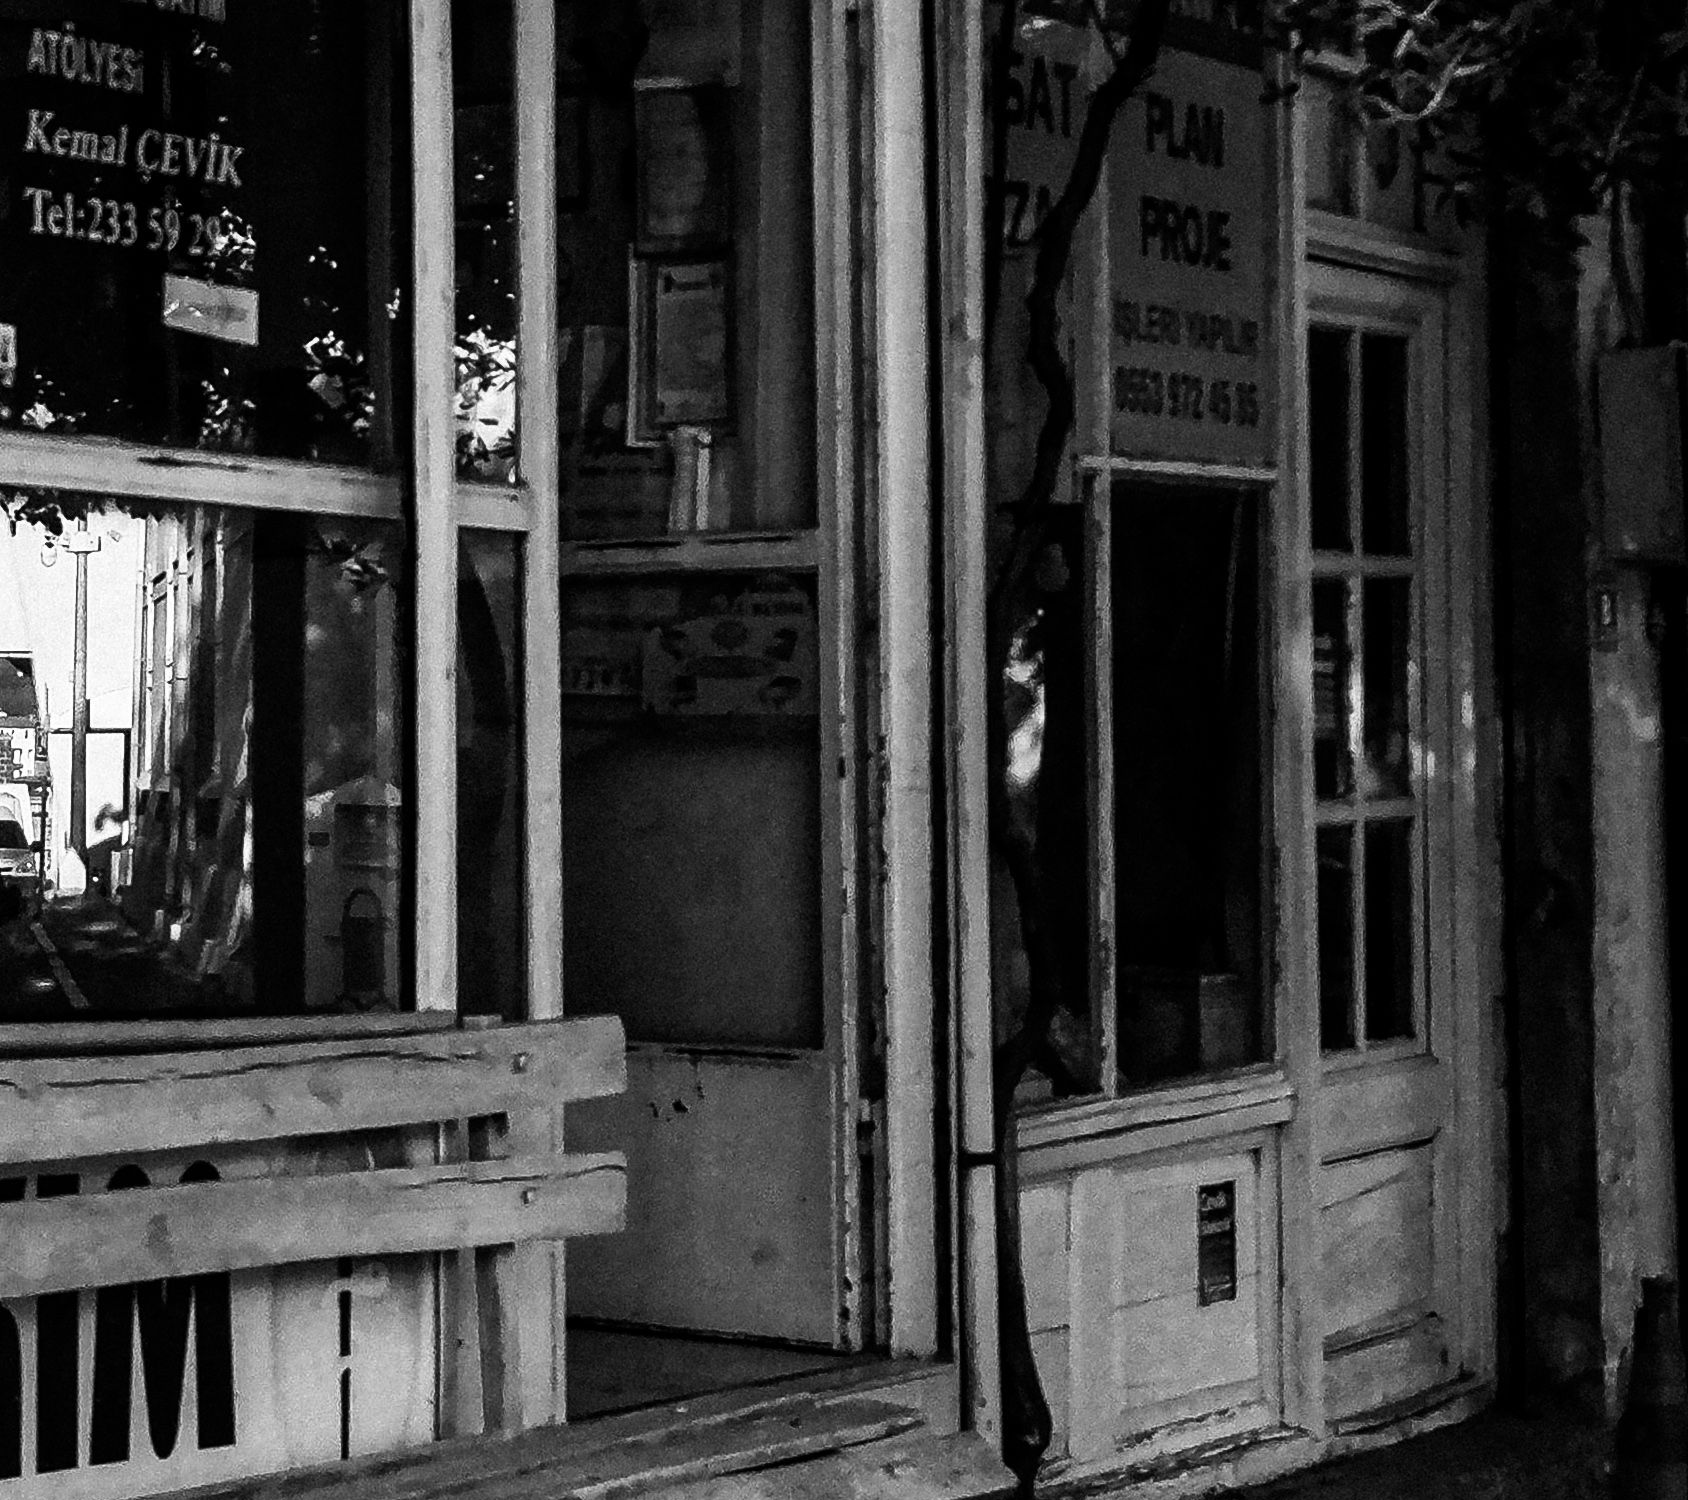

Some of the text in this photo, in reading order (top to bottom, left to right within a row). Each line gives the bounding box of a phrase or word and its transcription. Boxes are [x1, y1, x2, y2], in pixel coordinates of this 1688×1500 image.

[22, 108, 246, 188] Kemal ÇEVİK
[1146, 91, 1225, 169] PLAN
[146, 206, 182, 252] 59
